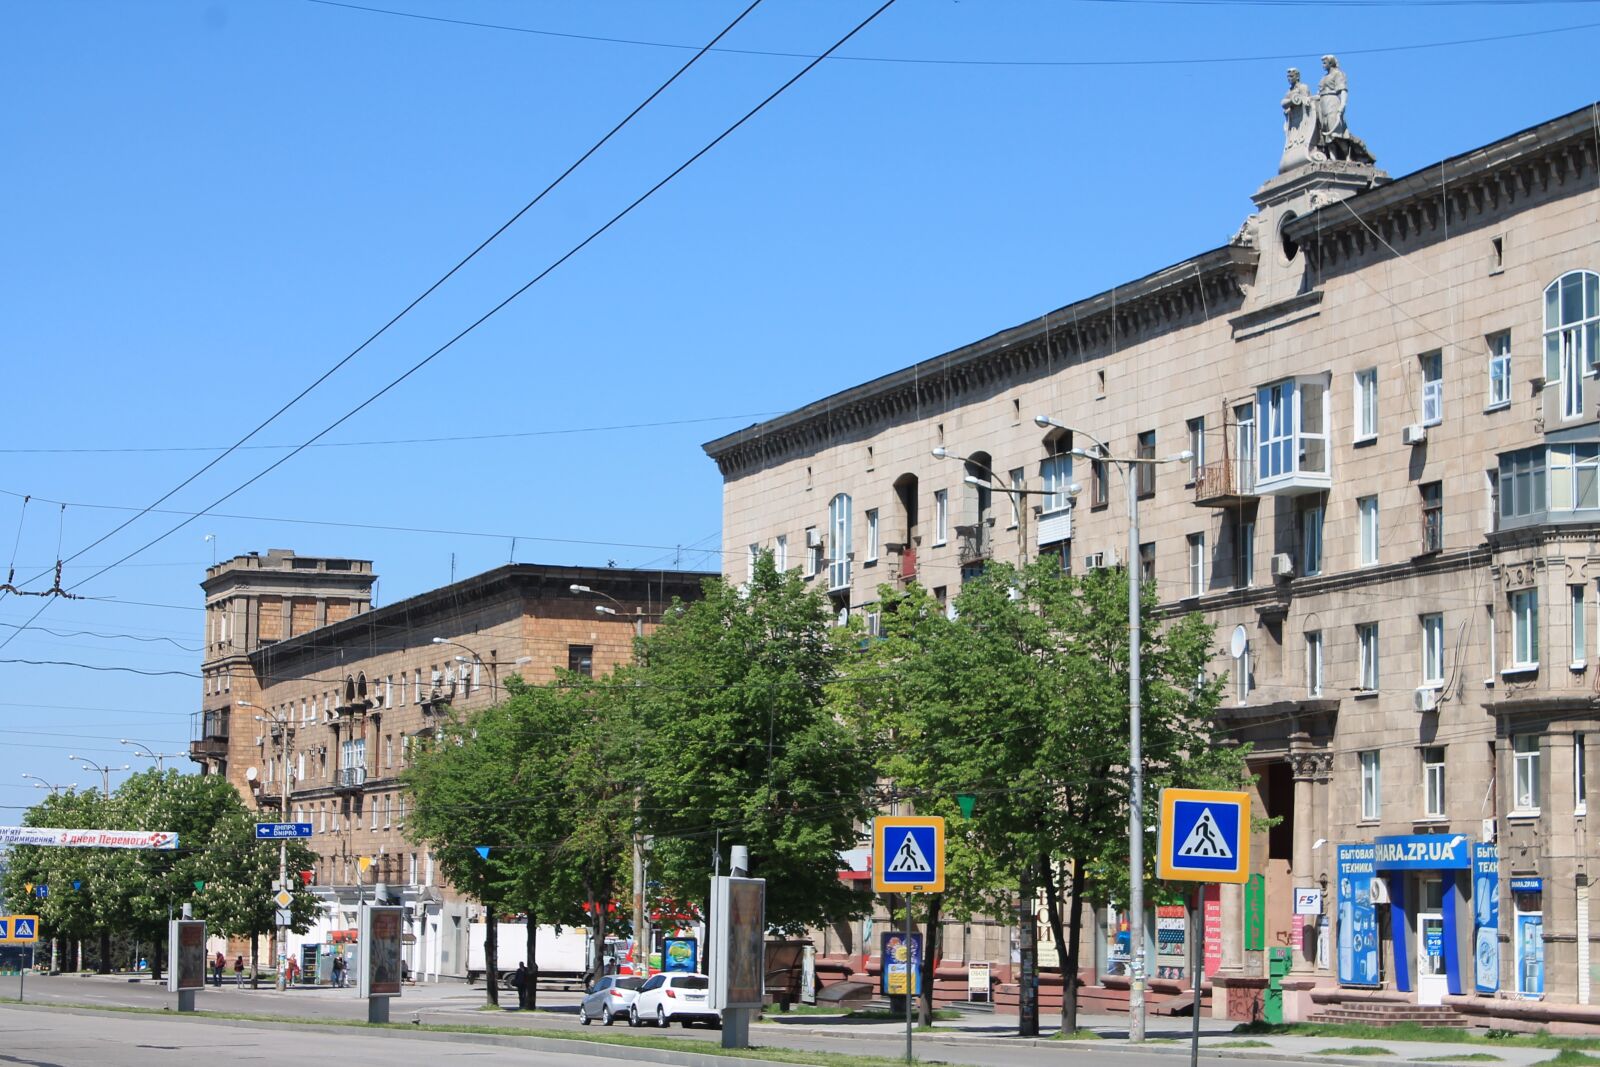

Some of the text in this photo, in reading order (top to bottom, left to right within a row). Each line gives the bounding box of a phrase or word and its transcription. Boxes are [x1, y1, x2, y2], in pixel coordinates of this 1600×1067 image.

[98, 835, 151, 846] Перемоги!
[1340, 849, 1374, 860] БЫТОВАЯ
[1342, 862, 1373, 873] ТЕХНИКА
